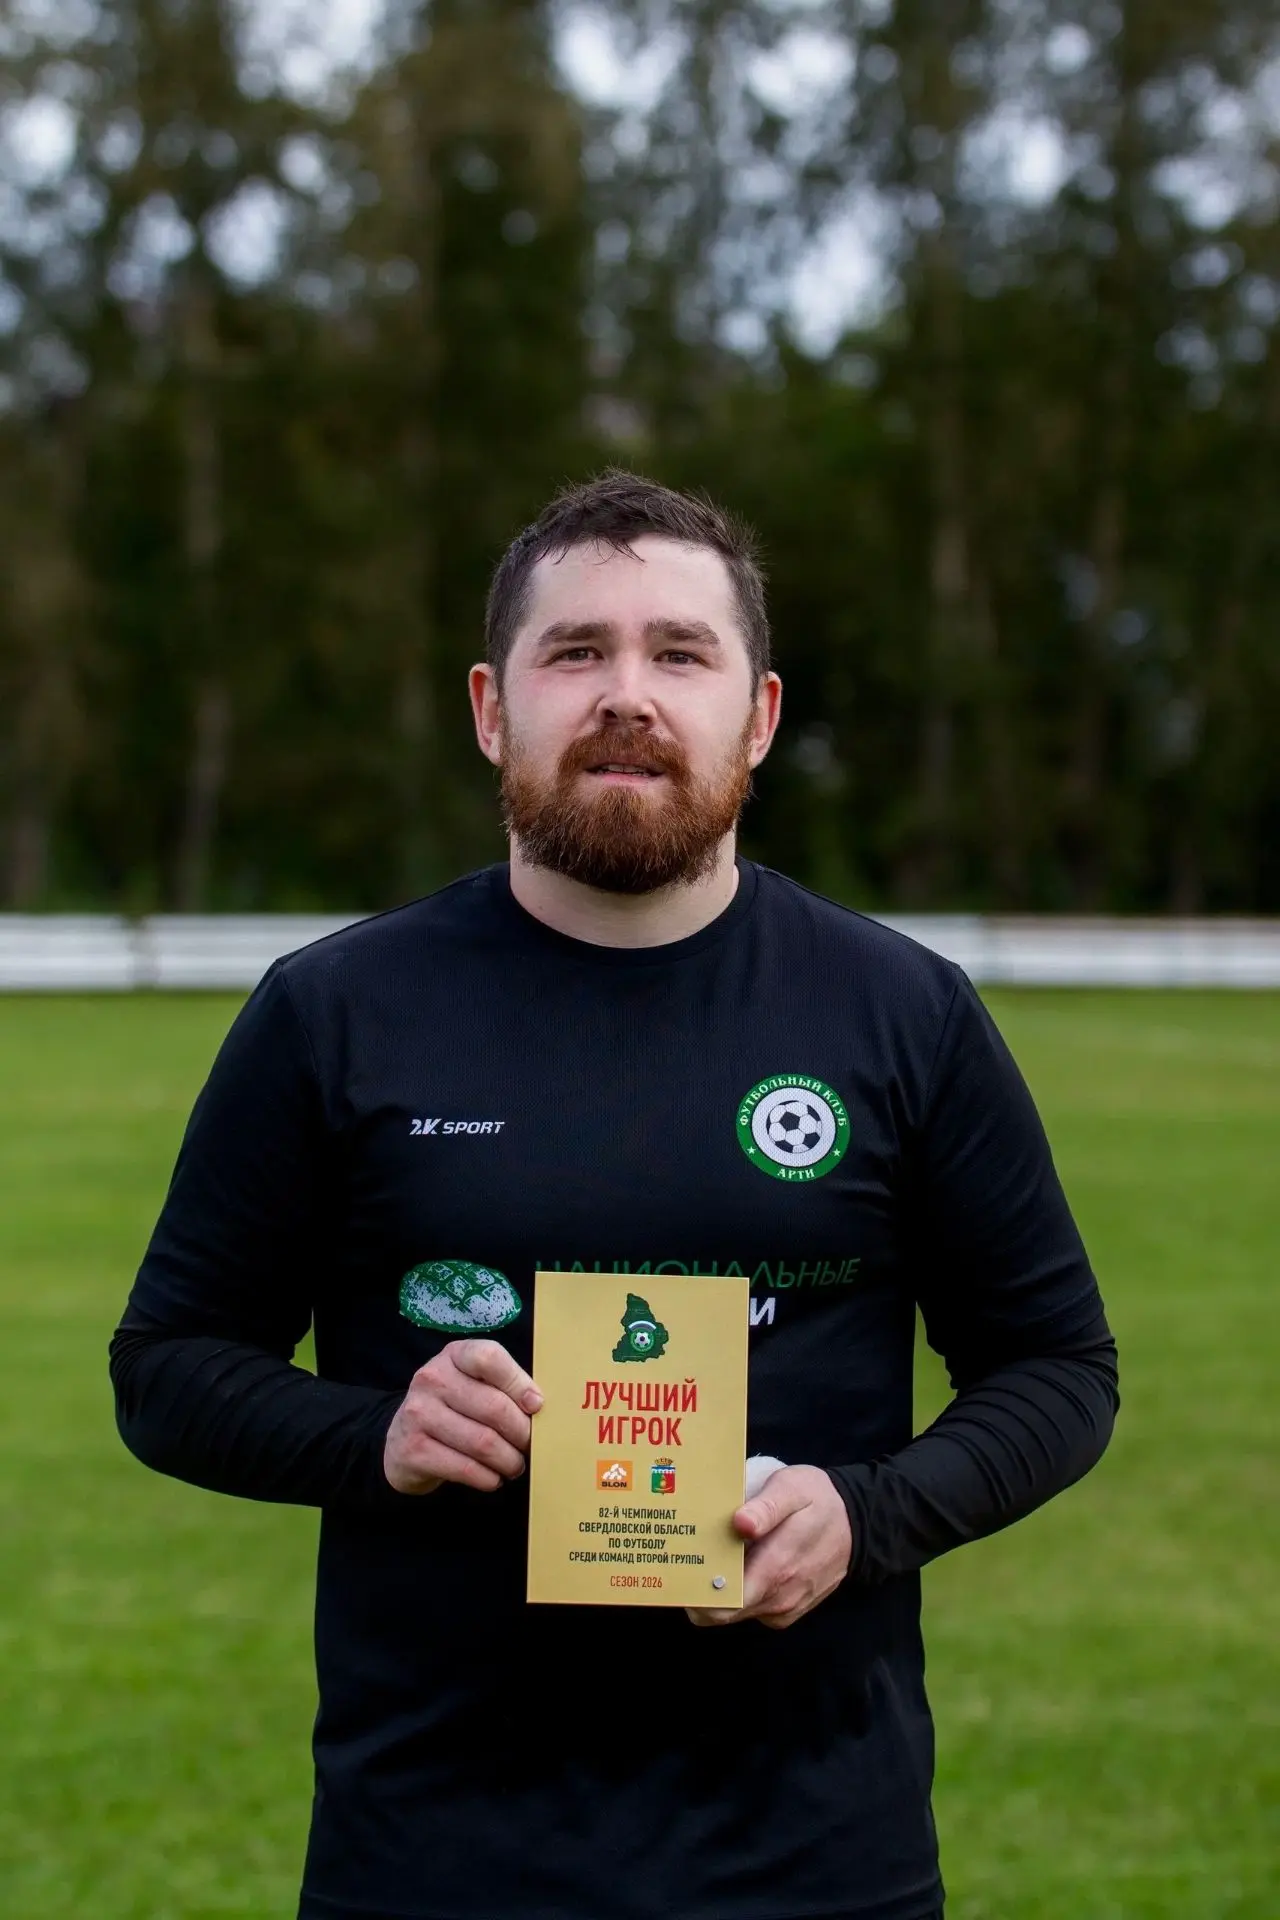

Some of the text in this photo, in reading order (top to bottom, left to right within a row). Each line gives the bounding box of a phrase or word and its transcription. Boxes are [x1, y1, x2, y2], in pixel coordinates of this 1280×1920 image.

[740, 1076, 847, 1127] ФУТБОЛЬНЫЙ КЛУБ
[409, 1118, 505, 1135] 2K SPORT
[777, 1168, 815, 1179] АРТИ
[582, 1378, 697, 1412] ЛУЧШИЙ
[598, 1415, 682, 1446] ИГРОК
[598, 1506, 677, 1520] 82-Й ЧЕМПИОНАТ
[579, 1521, 696, 1536] СВЕРДЛОВСКОЙ ОБЛАСТИ
[608, 1537, 666, 1550] ПО ФУТБОЛУ
[569, 1551, 705, 1565] СРЕДИ КОМАНД ВТОРОЙ ГРУППЫ
[610, 1575, 663, 1589] СЕЗОН 2026
